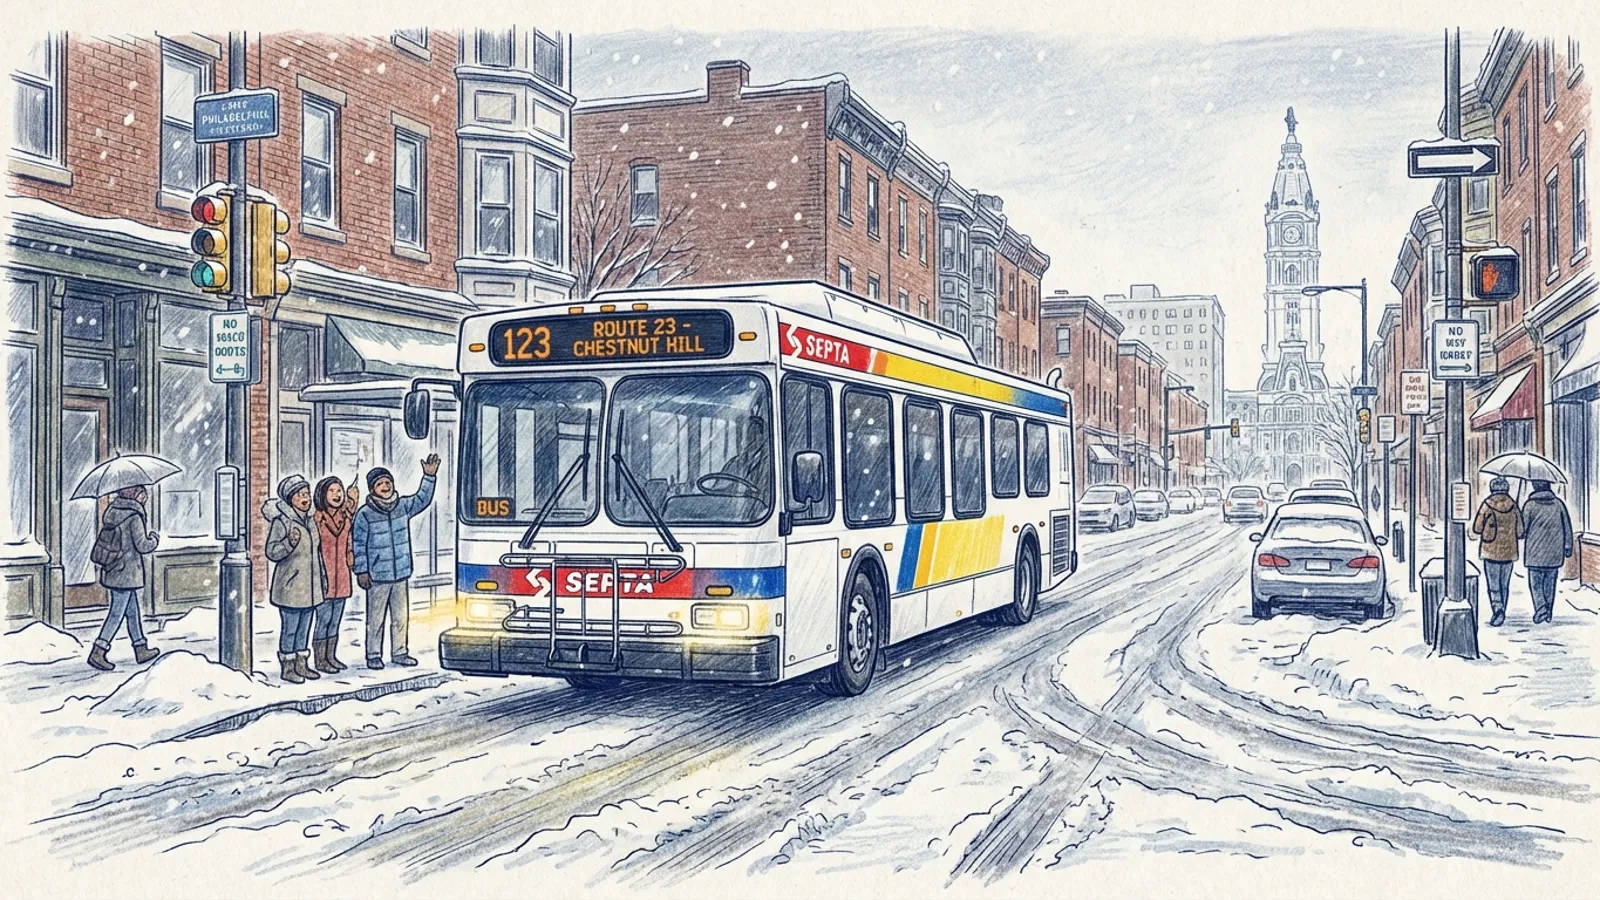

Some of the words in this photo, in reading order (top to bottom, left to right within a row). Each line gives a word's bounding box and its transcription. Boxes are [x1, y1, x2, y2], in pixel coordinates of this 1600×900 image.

[223, 319, 238, 329] NO
[593, 319, 648, 338] ROUTE
[654, 317, 676, 335] 23
[1448, 326, 1464, 336] NO
[504, 326, 551, 360] 123
[573, 337, 660, 357] CHESTNUT
[666, 335, 705, 353] HILL
[805, 334, 850, 365] SEPTA
[477, 500, 510, 516] BUS
[564, 571, 655, 594] SEPTA
